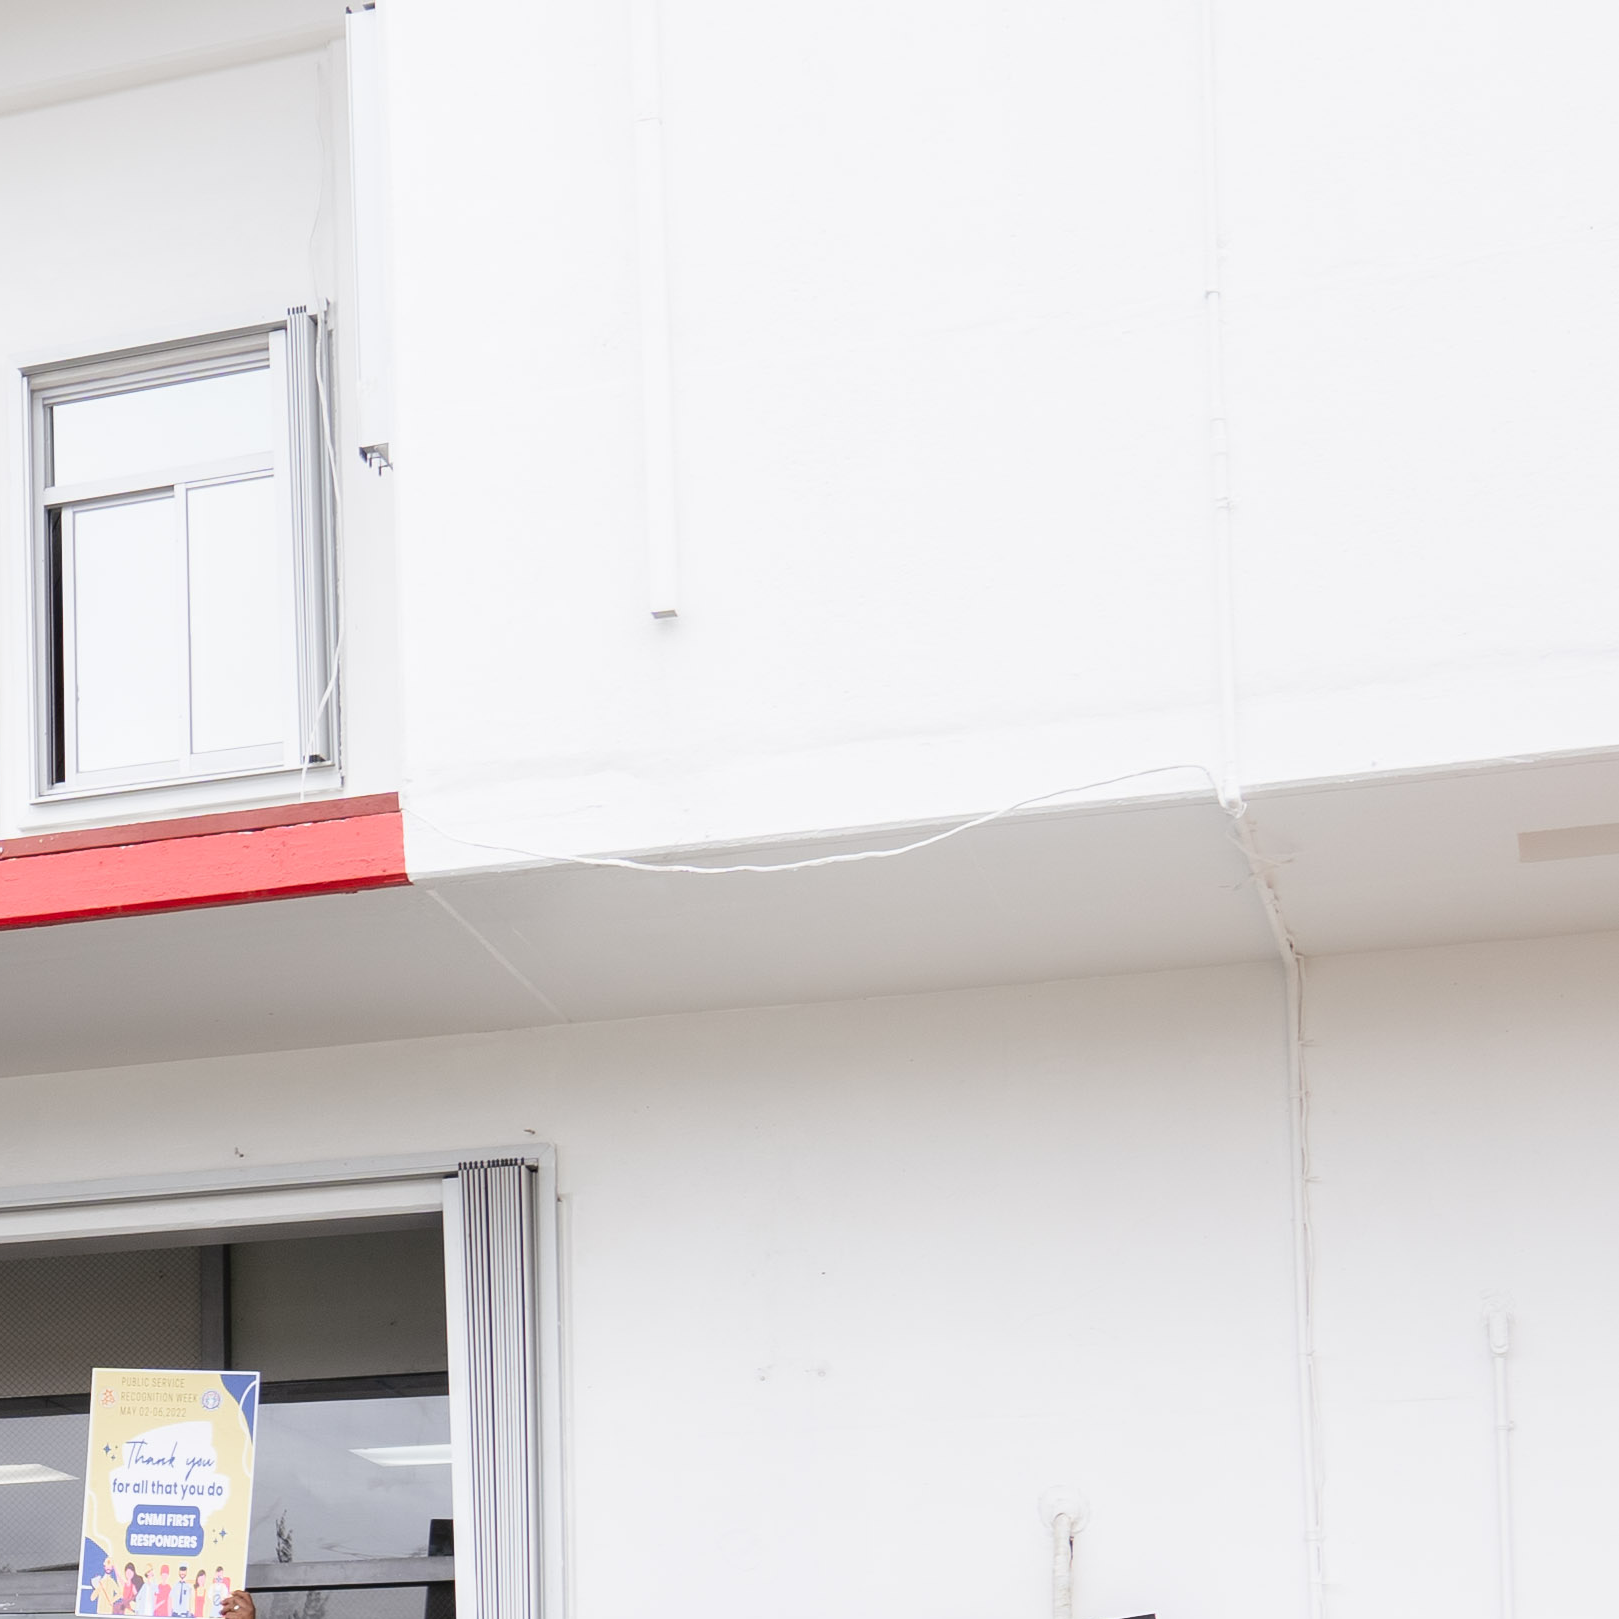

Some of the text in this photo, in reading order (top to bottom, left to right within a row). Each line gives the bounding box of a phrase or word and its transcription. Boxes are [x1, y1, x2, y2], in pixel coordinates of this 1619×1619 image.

[121, 1376, 186, 1389] PUBLIC SERVICE
[120, 1391, 199, 1404] RECOGNITION WEEK
[119, 1406, 138, 1417] MAY
[125, 1440, 215, 1483] Thank you
[112, 1478, 224, 1500] for all that you do
[136, 1513, 196, 1527] CNMI FIRST
[130, 1533, 198, 1549] RESPONDERS
